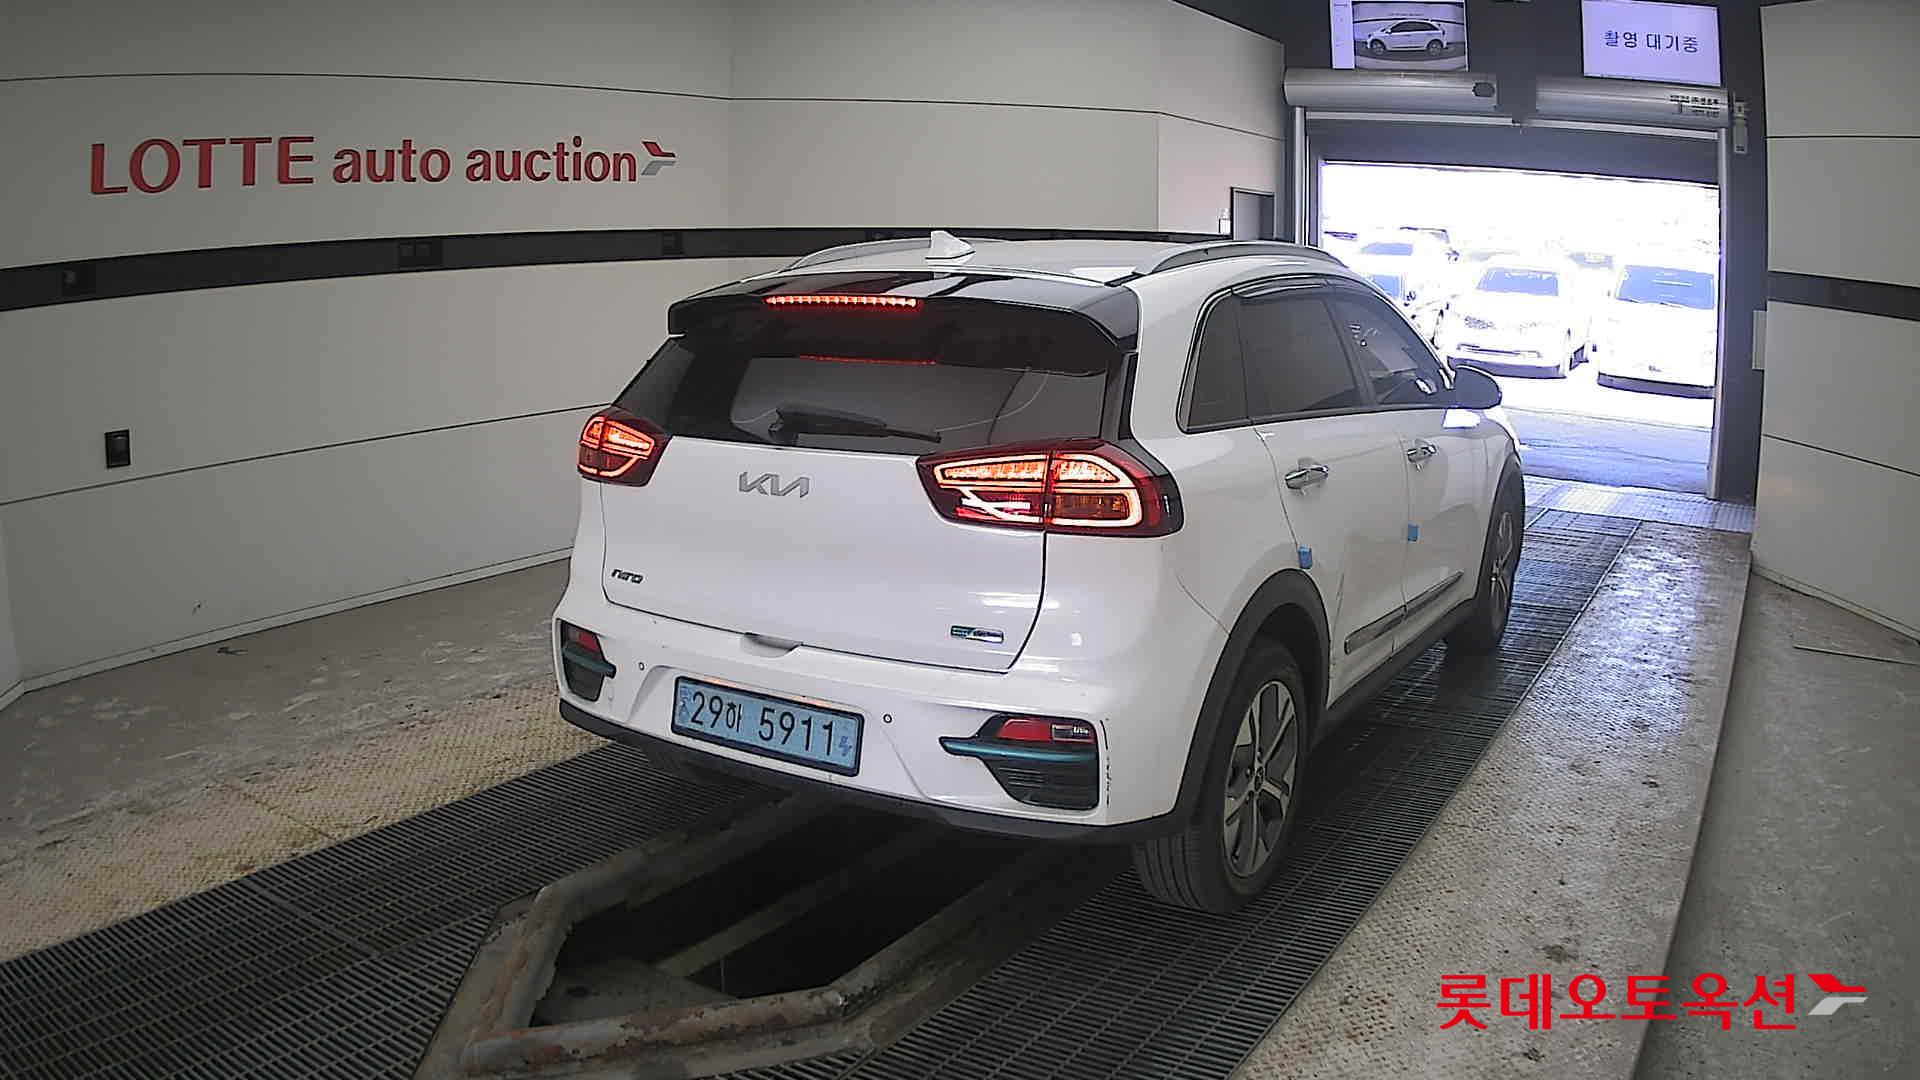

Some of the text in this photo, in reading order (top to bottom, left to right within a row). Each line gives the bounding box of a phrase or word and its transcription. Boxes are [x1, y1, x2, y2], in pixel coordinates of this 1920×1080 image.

[1604, 30, 1698, 53] 촬영 대기중
[90, 135, 638, 194] LOTTE auto auction
[739, 472, 810, 498] KIA
[691, 691, 834, 756] 29하 5911
